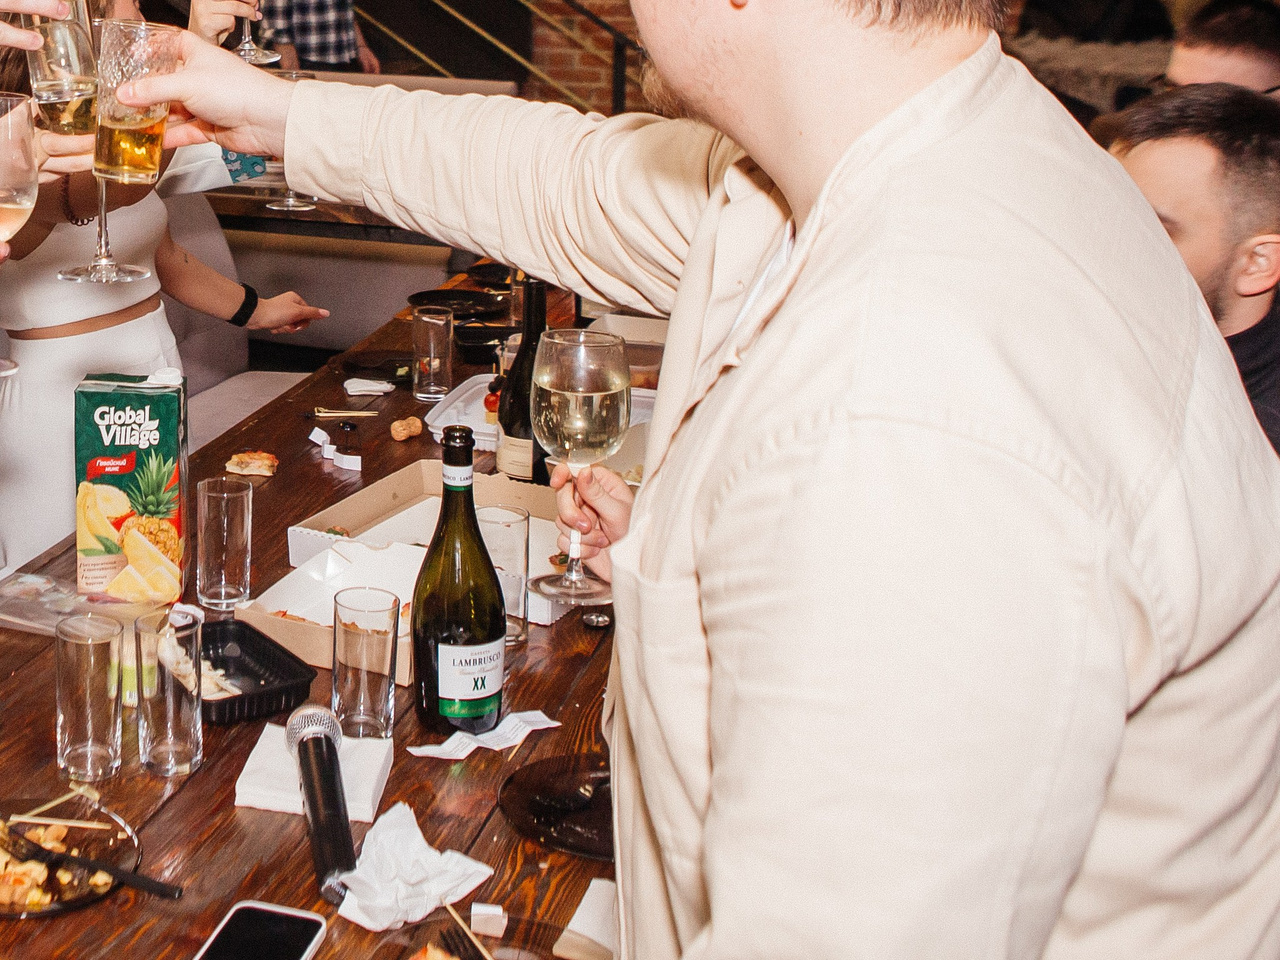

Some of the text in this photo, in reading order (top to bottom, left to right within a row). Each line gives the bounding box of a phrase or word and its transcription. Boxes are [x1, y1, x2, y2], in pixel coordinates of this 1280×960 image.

[94, 405, 150, 425] Global
[99, 425, 160, 449] Village
[452, 651, 501, 667] LAMBRUSCO
[473, 676, 487, 691] XX
